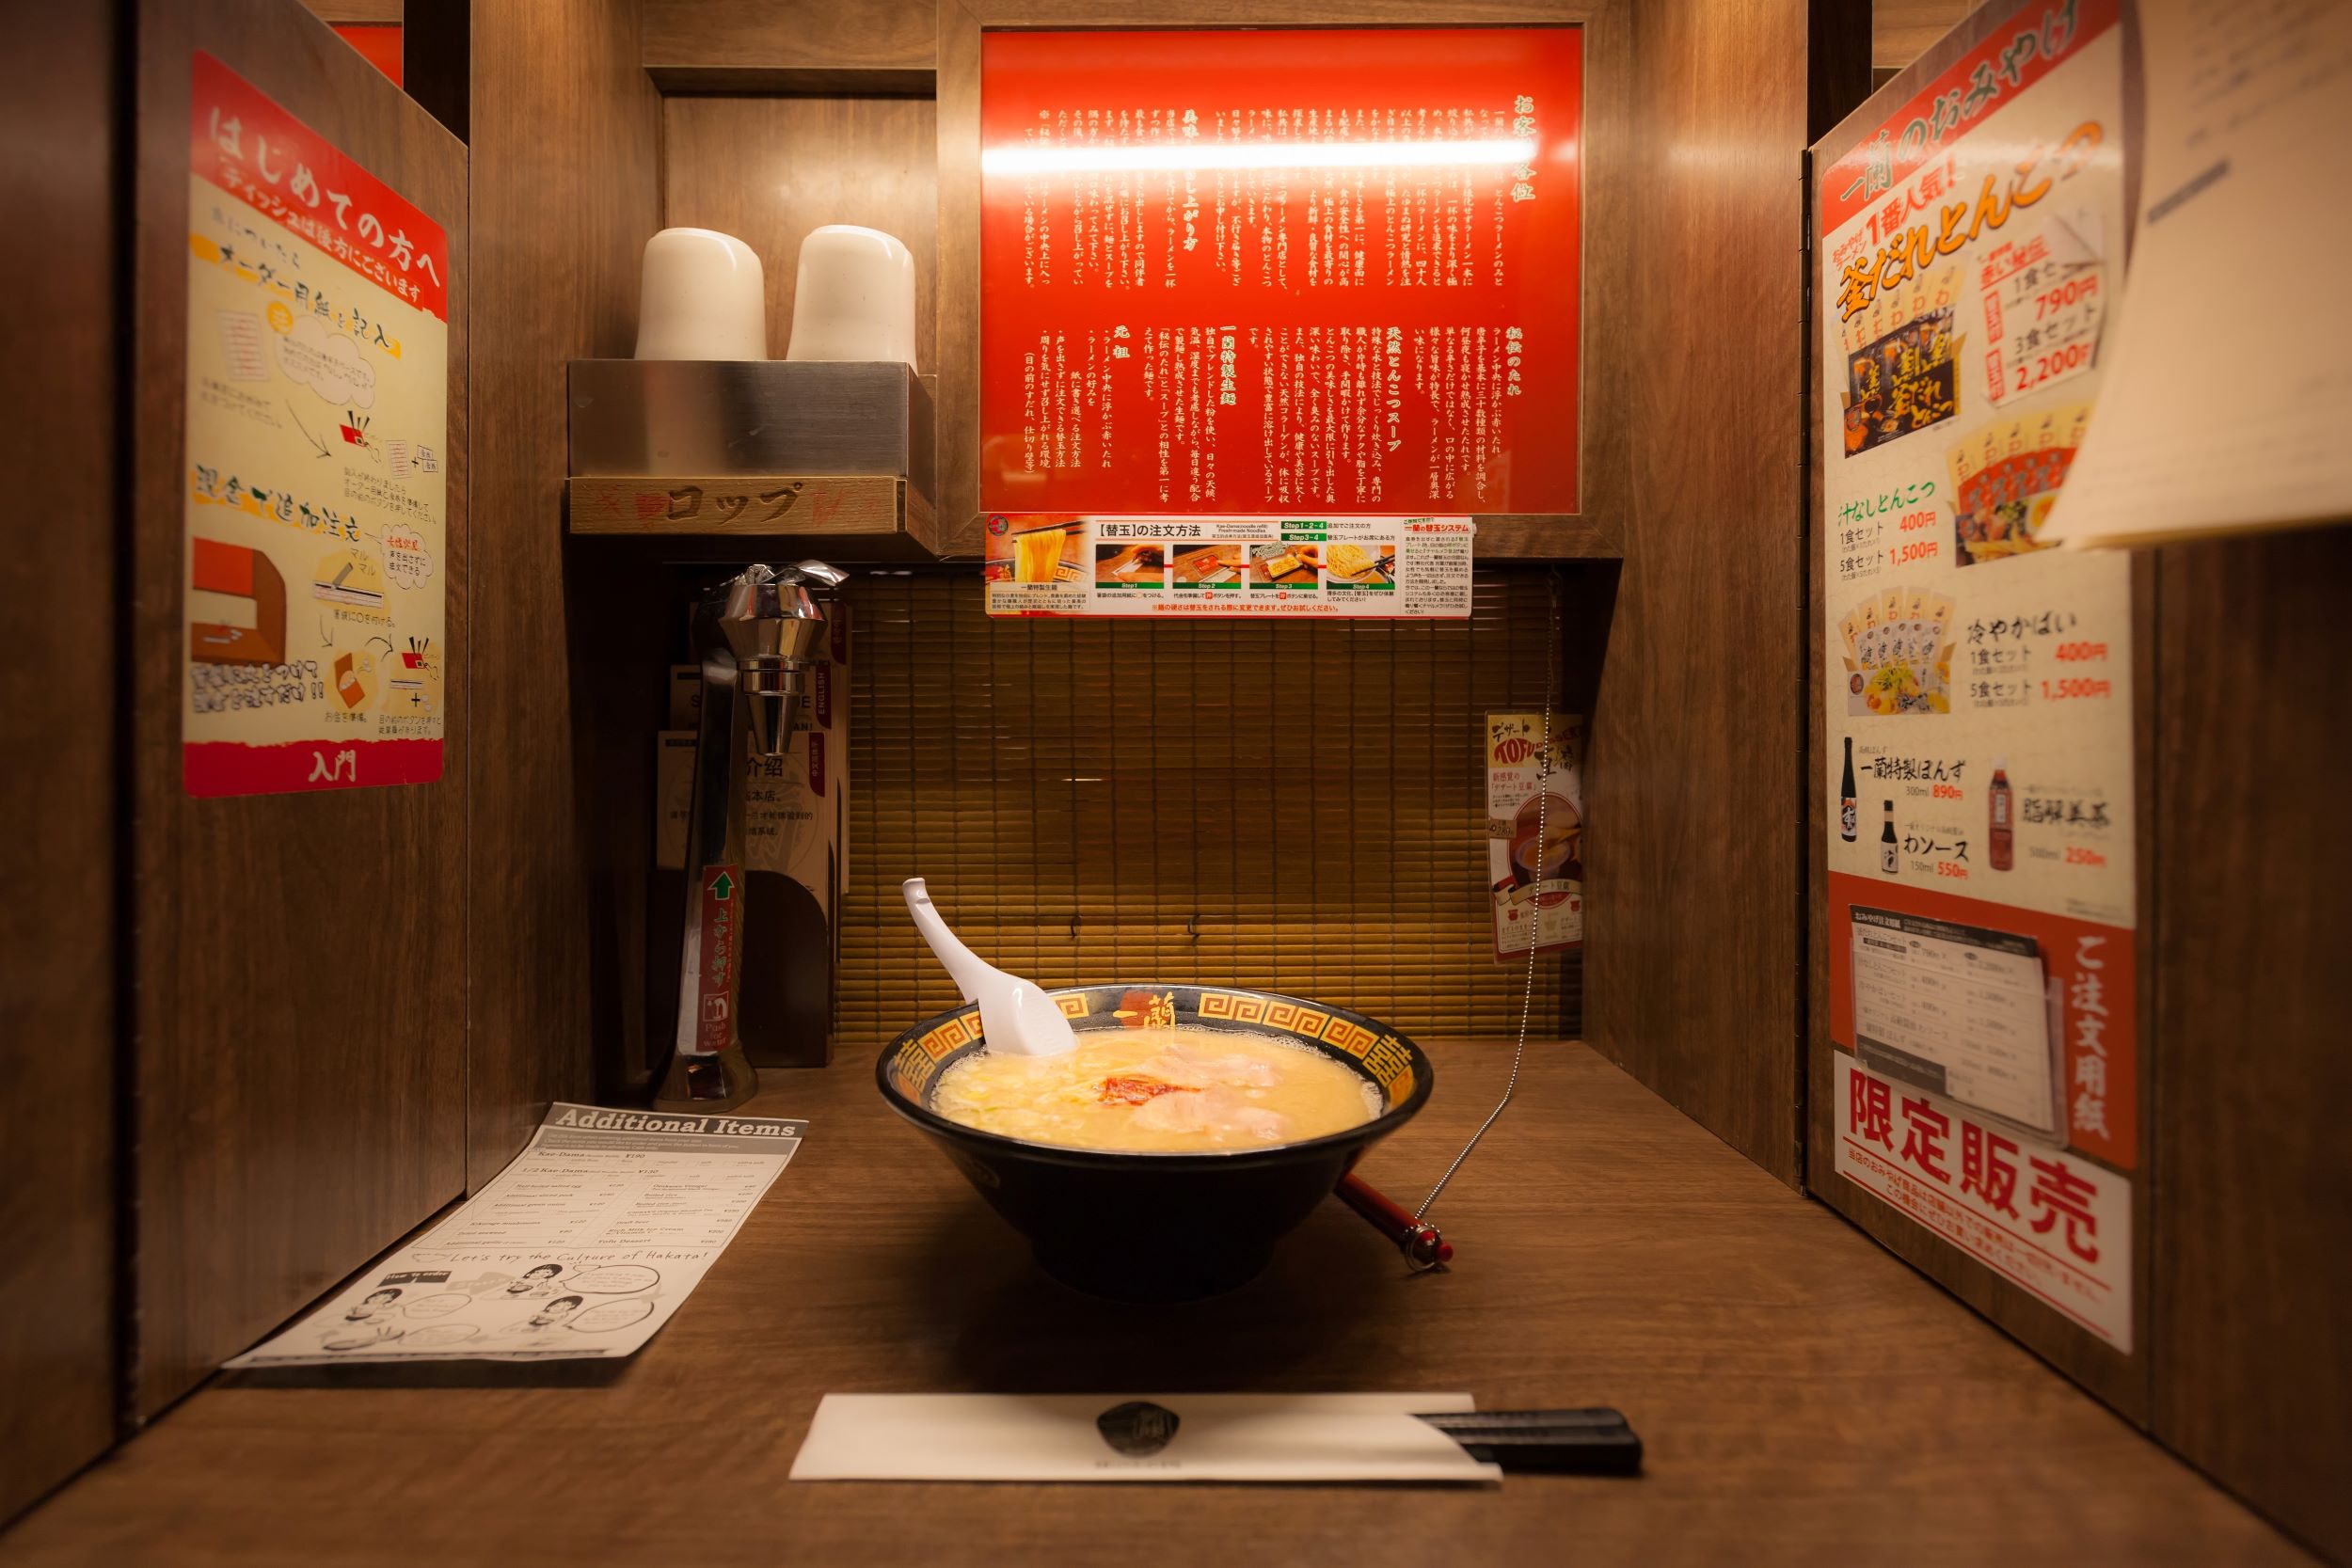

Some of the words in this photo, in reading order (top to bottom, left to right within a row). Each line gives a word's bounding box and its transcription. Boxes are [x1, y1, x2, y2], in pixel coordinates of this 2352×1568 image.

[1840, 0, 2081, 202] 一蘭のおみやげ
[1511, 95, 1536, 202] お客各位
[209, 105, 440, 288] はじめての方へ
[2035, 274, 2099, 321] 790円
[1113, 325, 1130, 359] 元祖
[1506, 325, 1522, 396] 秘伝のたれ
[1220, 325, 1236, 404] 一蘭特製生麺
[1386, 326, 1403, 451] 天然とんこつスープ
[196, 463, 361, 543] 現金で追加注文
[1837, 481, 1935, 527] 汁なしとんこつ
[1840, 520, 1883, 545] 1食セット
[1899, 511, 1936, 532] 400円
[1839, 549, 1883, 573] 5食セット
[1889, 542, 1938, 566] 1,500円
[1970, 644, 2031, 665] 1食セット
[2055, 640, 2108, 662] 400円
[1970, 678, 2031, 698] 5食セット
[2040, 676, 2112, 702] 1,500円
[308, 750, 358, 783] 入門
[1905, 785, 1930, 797] 300ml
[1932, 784, 1963, 800] 890円
[1903, 833, 1969, 863] わソース
[1911, 861, 1934, 874] 150ml
[1937, 861, 1969, 880] 550円
[710, 907, 729, 988] 上から押す
[706, 1021, 726, 1033] Push
[2070, 934, 2111, 1142] ご注文用紙
[555, 1108, 706, 1134] Additional
[712, 1119, 796, 1137] Items
[1849, 1066, 2101, 1266] 限定販売
[450, 1251, 490, 1263] Let's
[498, 1253, 523, 1264] try
[529, 1251, 552, 1260] the
[560, 1250, 619, 1262] Culture
[623, 1250, 641, 1260] of
